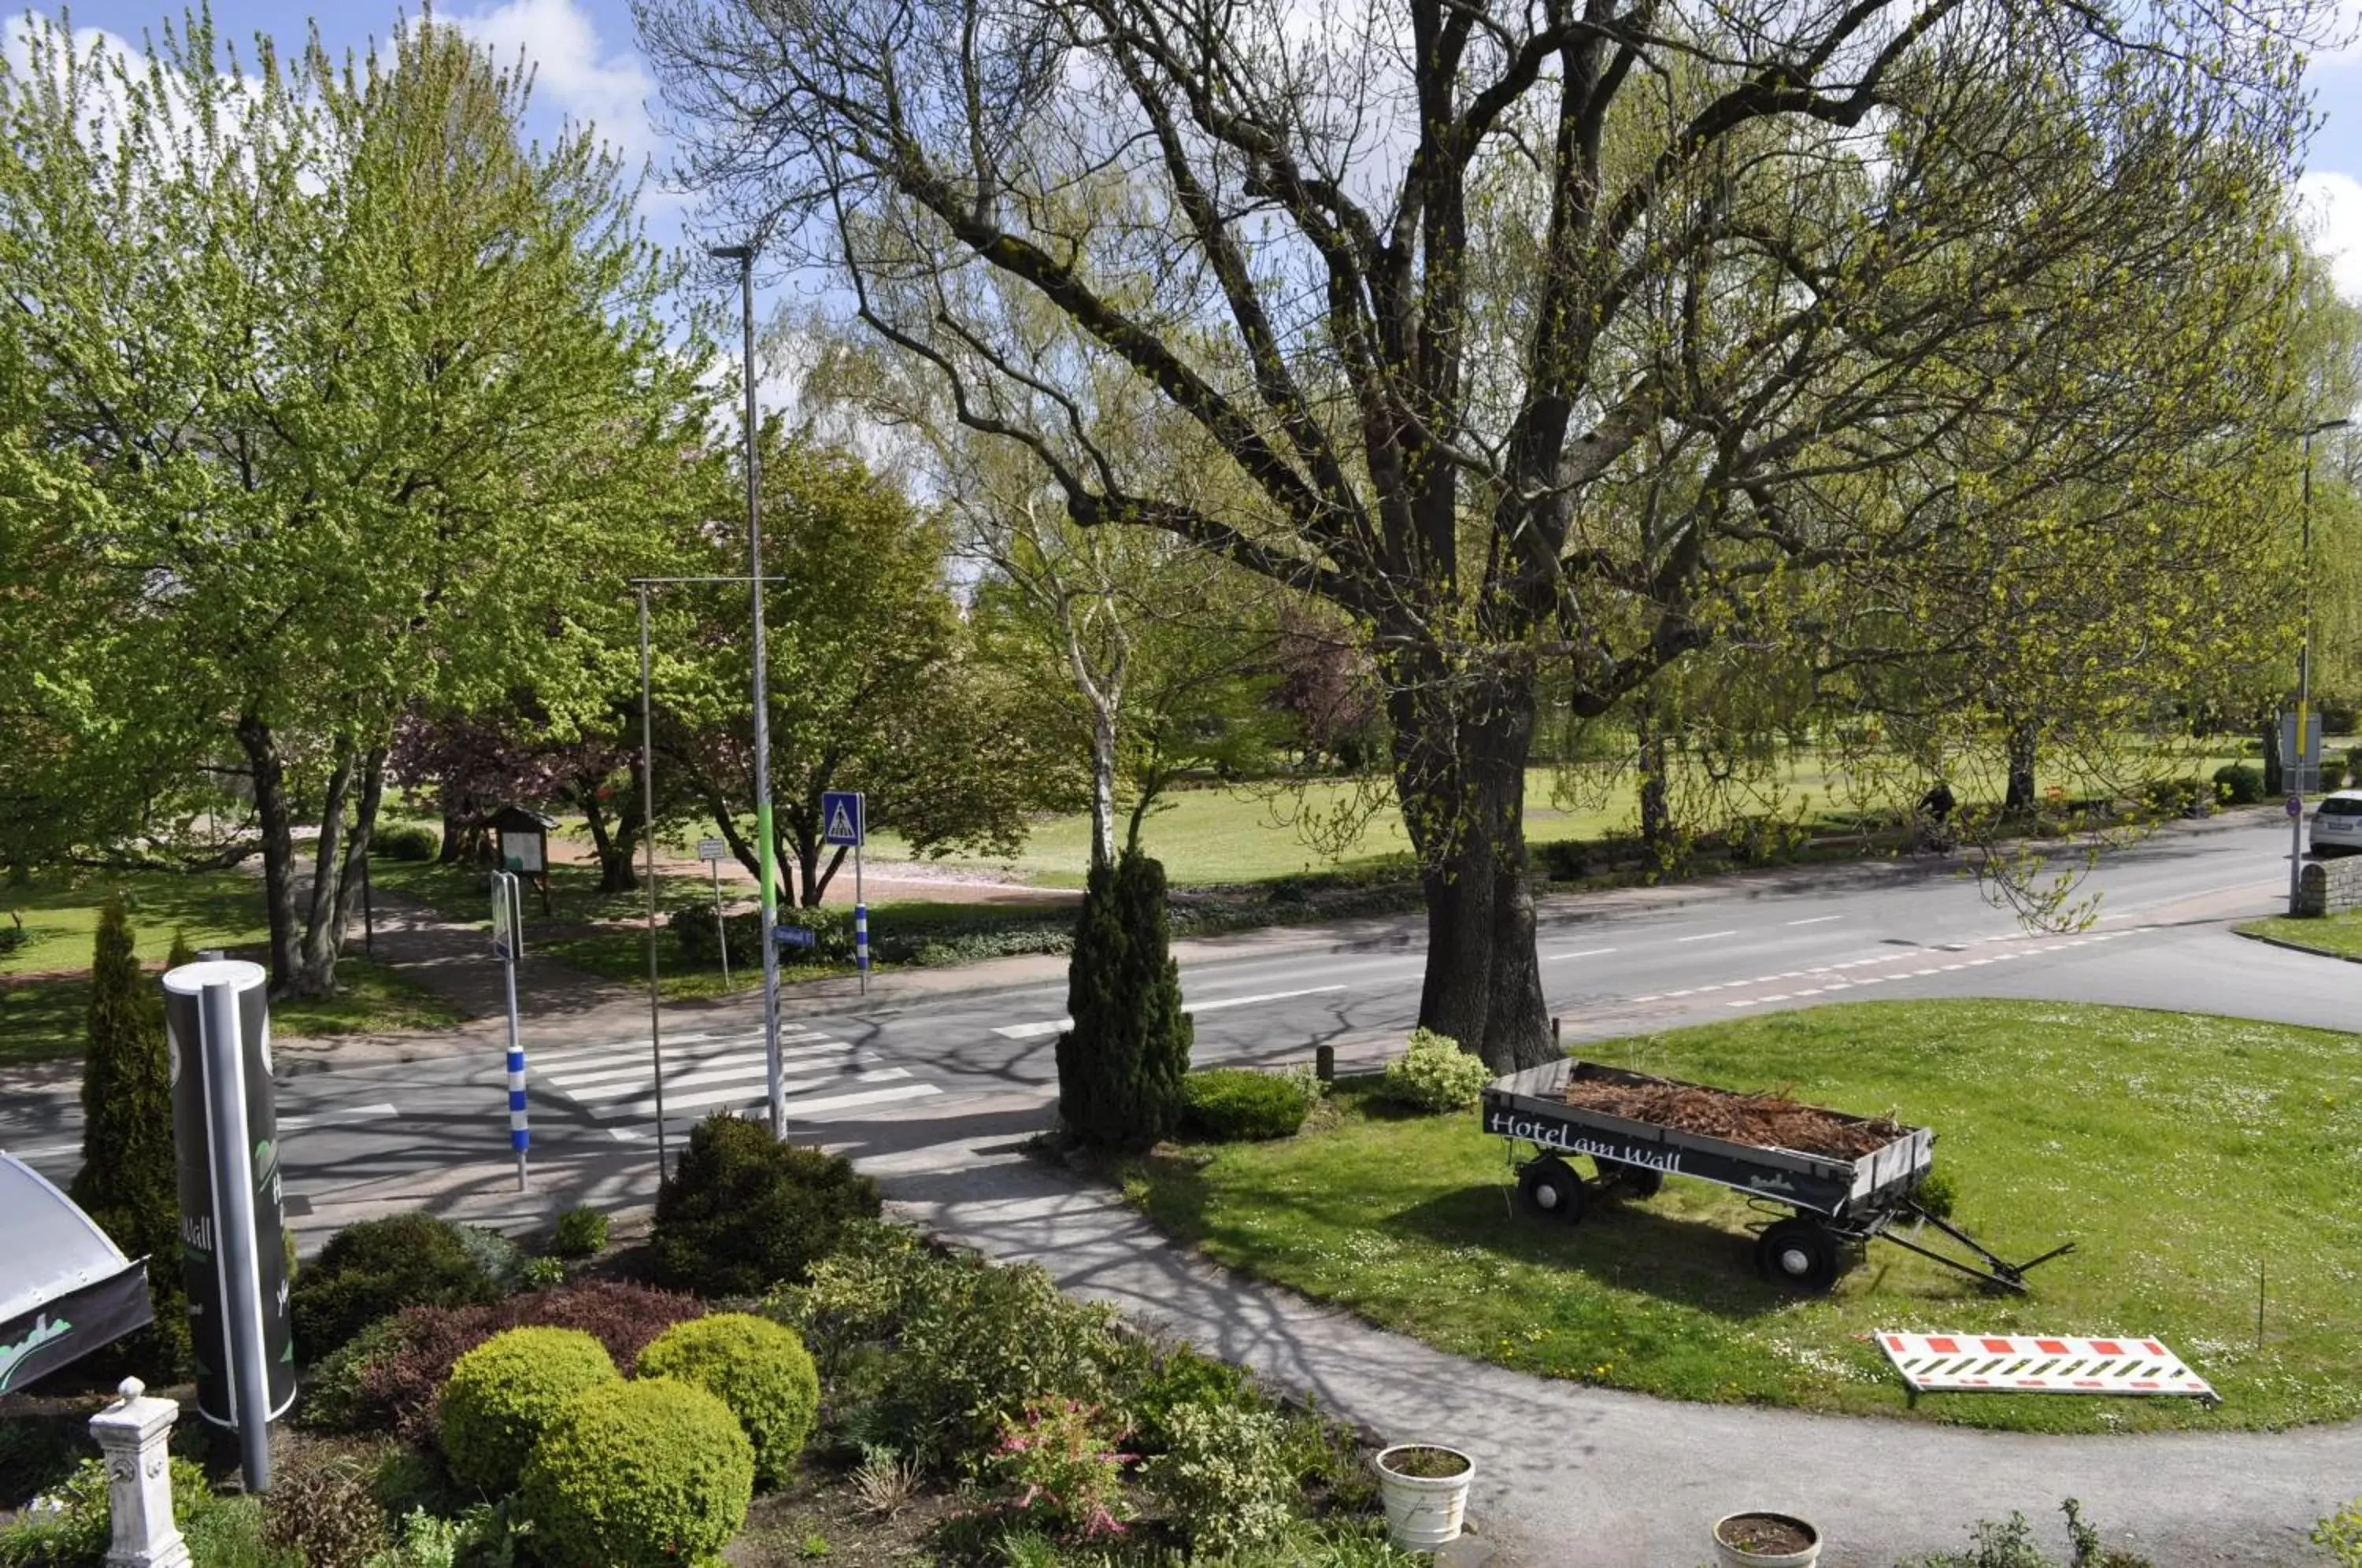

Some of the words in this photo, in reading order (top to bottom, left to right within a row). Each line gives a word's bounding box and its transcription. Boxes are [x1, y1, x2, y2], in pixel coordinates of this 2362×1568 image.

[1491, 1112, 1568, 1148] Hotel
[1575, 1137, 1614, 1158] am
[1624, 1146, 1680, 1172] Wall
